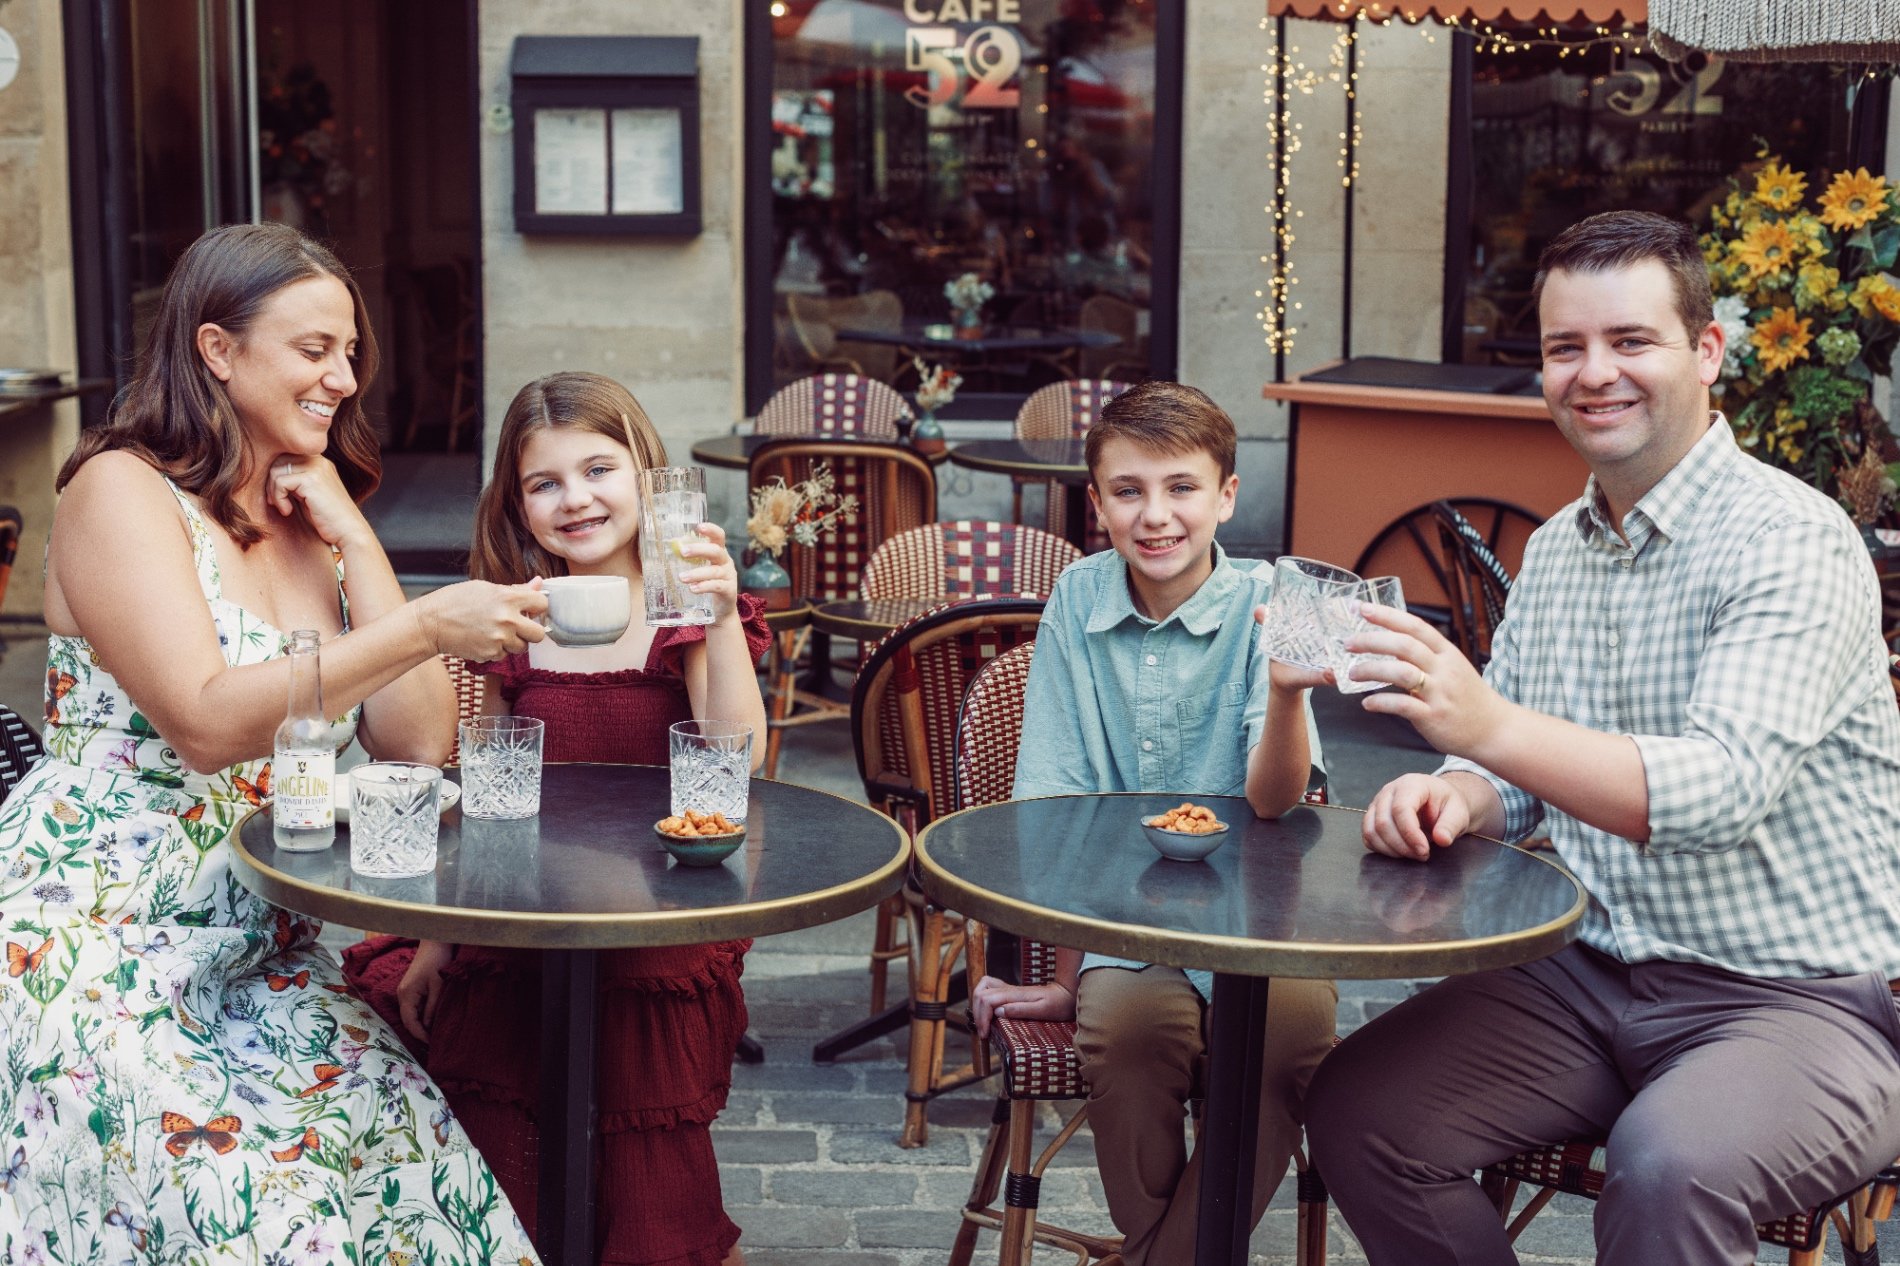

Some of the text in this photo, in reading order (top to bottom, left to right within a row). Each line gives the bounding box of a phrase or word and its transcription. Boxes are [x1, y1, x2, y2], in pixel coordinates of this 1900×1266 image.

[904, 0, 1021, 24] CAFE
[904, 26, 1020, 109] 52
[1606, 38, 1725, 117] 52
